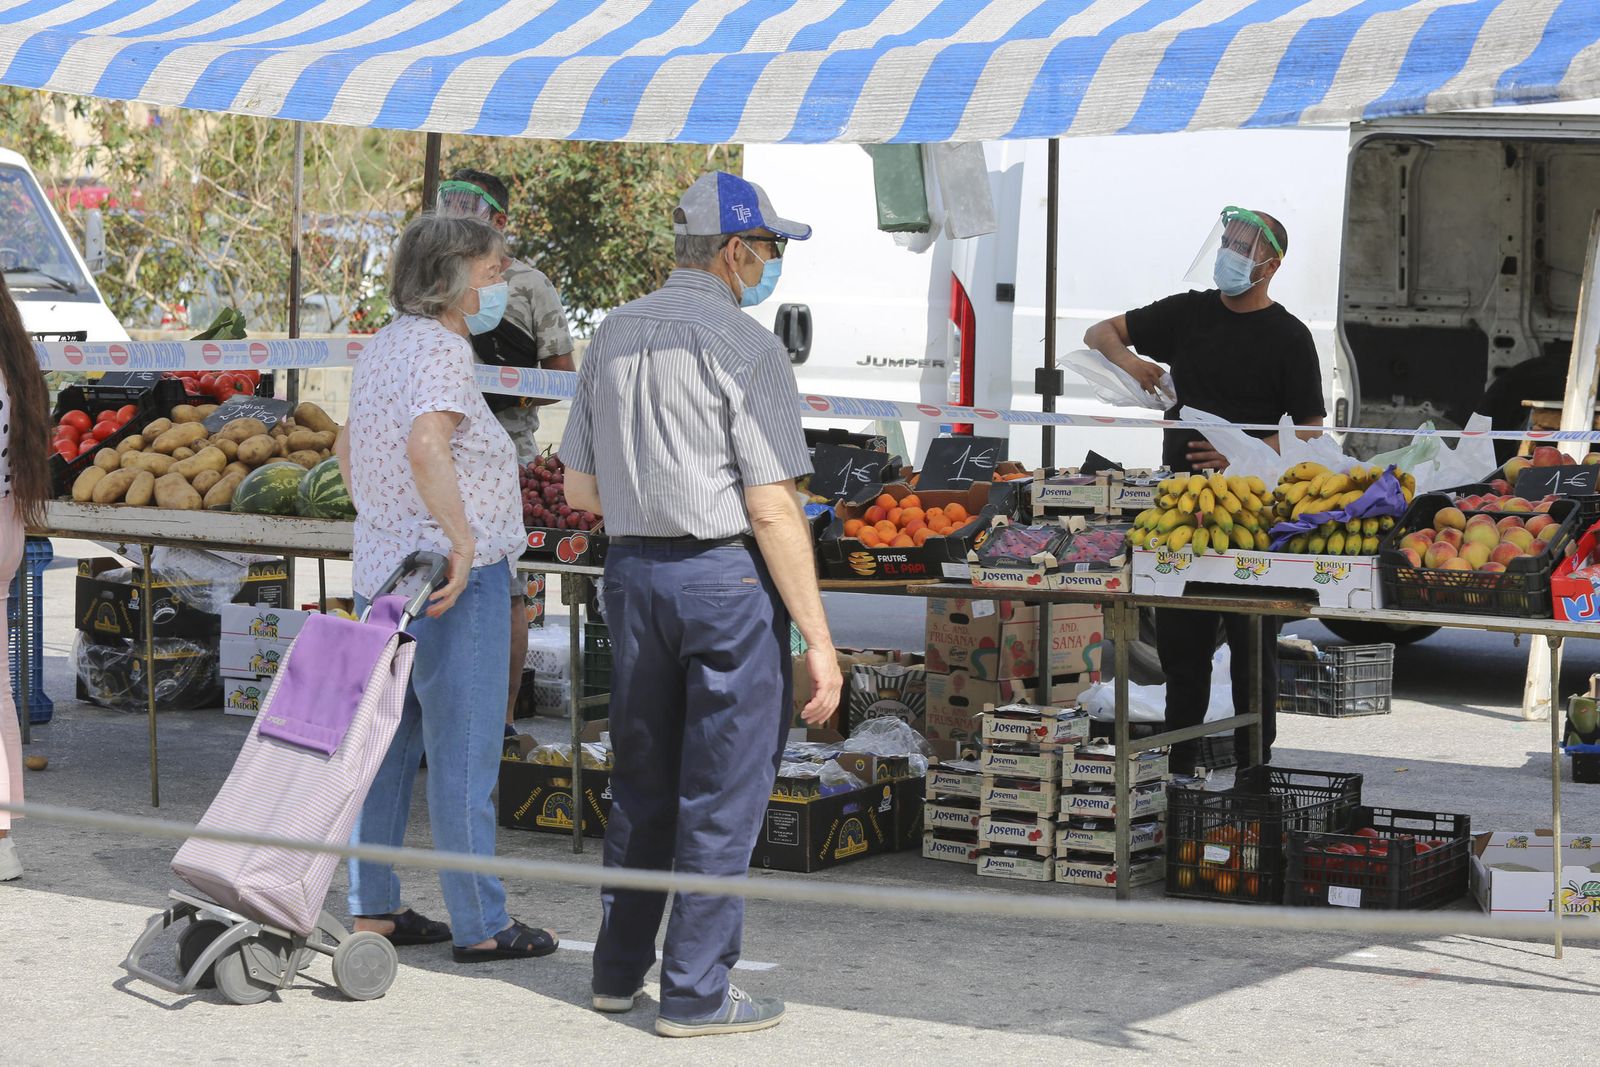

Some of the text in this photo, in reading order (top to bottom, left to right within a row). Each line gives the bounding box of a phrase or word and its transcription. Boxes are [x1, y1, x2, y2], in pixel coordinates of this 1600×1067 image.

[731, 204, 752, 223] TF
[856, 355, 946, 368] JUMPER
[1036, 487, 1072, 498] Josema
[1115, 488, 1151, 500] Josema
[981, 571, 1023, 582] Josema
[1059, 575, 1101, 586] Josema
[992, 722, 1031, 734] Josema
[987, 755, 1017, 765] Josema
[1071, 763, 1112, 775] Josema
[933, 775, 960, 785] Josema
[986, 790, 1018, 800] Josema
[585, 788, 609, 830] Palmerit
[1070, 797, 1109, 809] Josema
[932, 810, 969, 822] Josema
[987, 825, 1025, 836] Josema
[1063, 830, 1093, 840] Josema
[931, 842, 966, 855] Josema
[982, 858, 1015, 868] Josema
[1063, 867, 1102, 879] Josema
[1548, 899, 1600, 913] LMDOR
